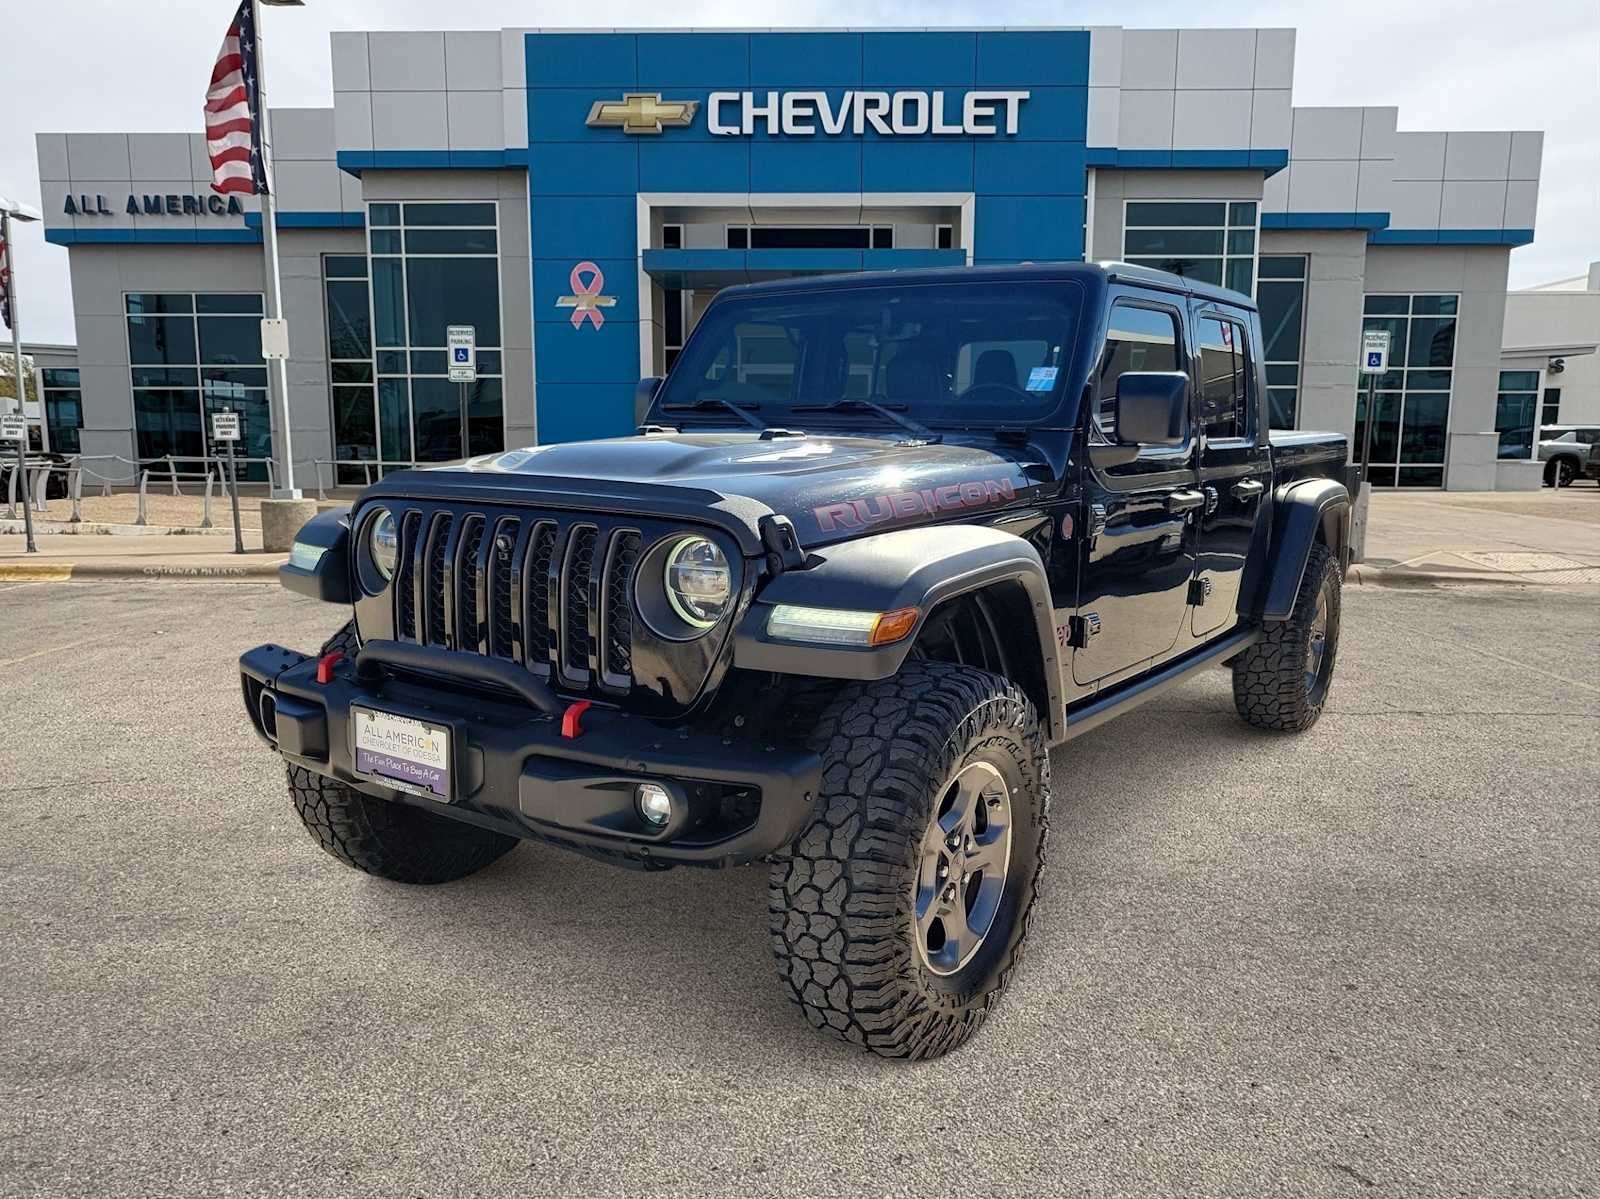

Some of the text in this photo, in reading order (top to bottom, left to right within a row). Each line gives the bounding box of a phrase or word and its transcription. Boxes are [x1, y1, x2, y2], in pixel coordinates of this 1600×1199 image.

[707, 90, 1030, 136] CHEVROLET
[64, 194, 113, 216] ALL
[814, 478, 1015, 533] RUBICON
[364, 724, 440, 753] ALL AMERICN
[363, 752, 373, 763] The
[386, 758, 402, 770] Place
[402, 763, 410, 773] To
